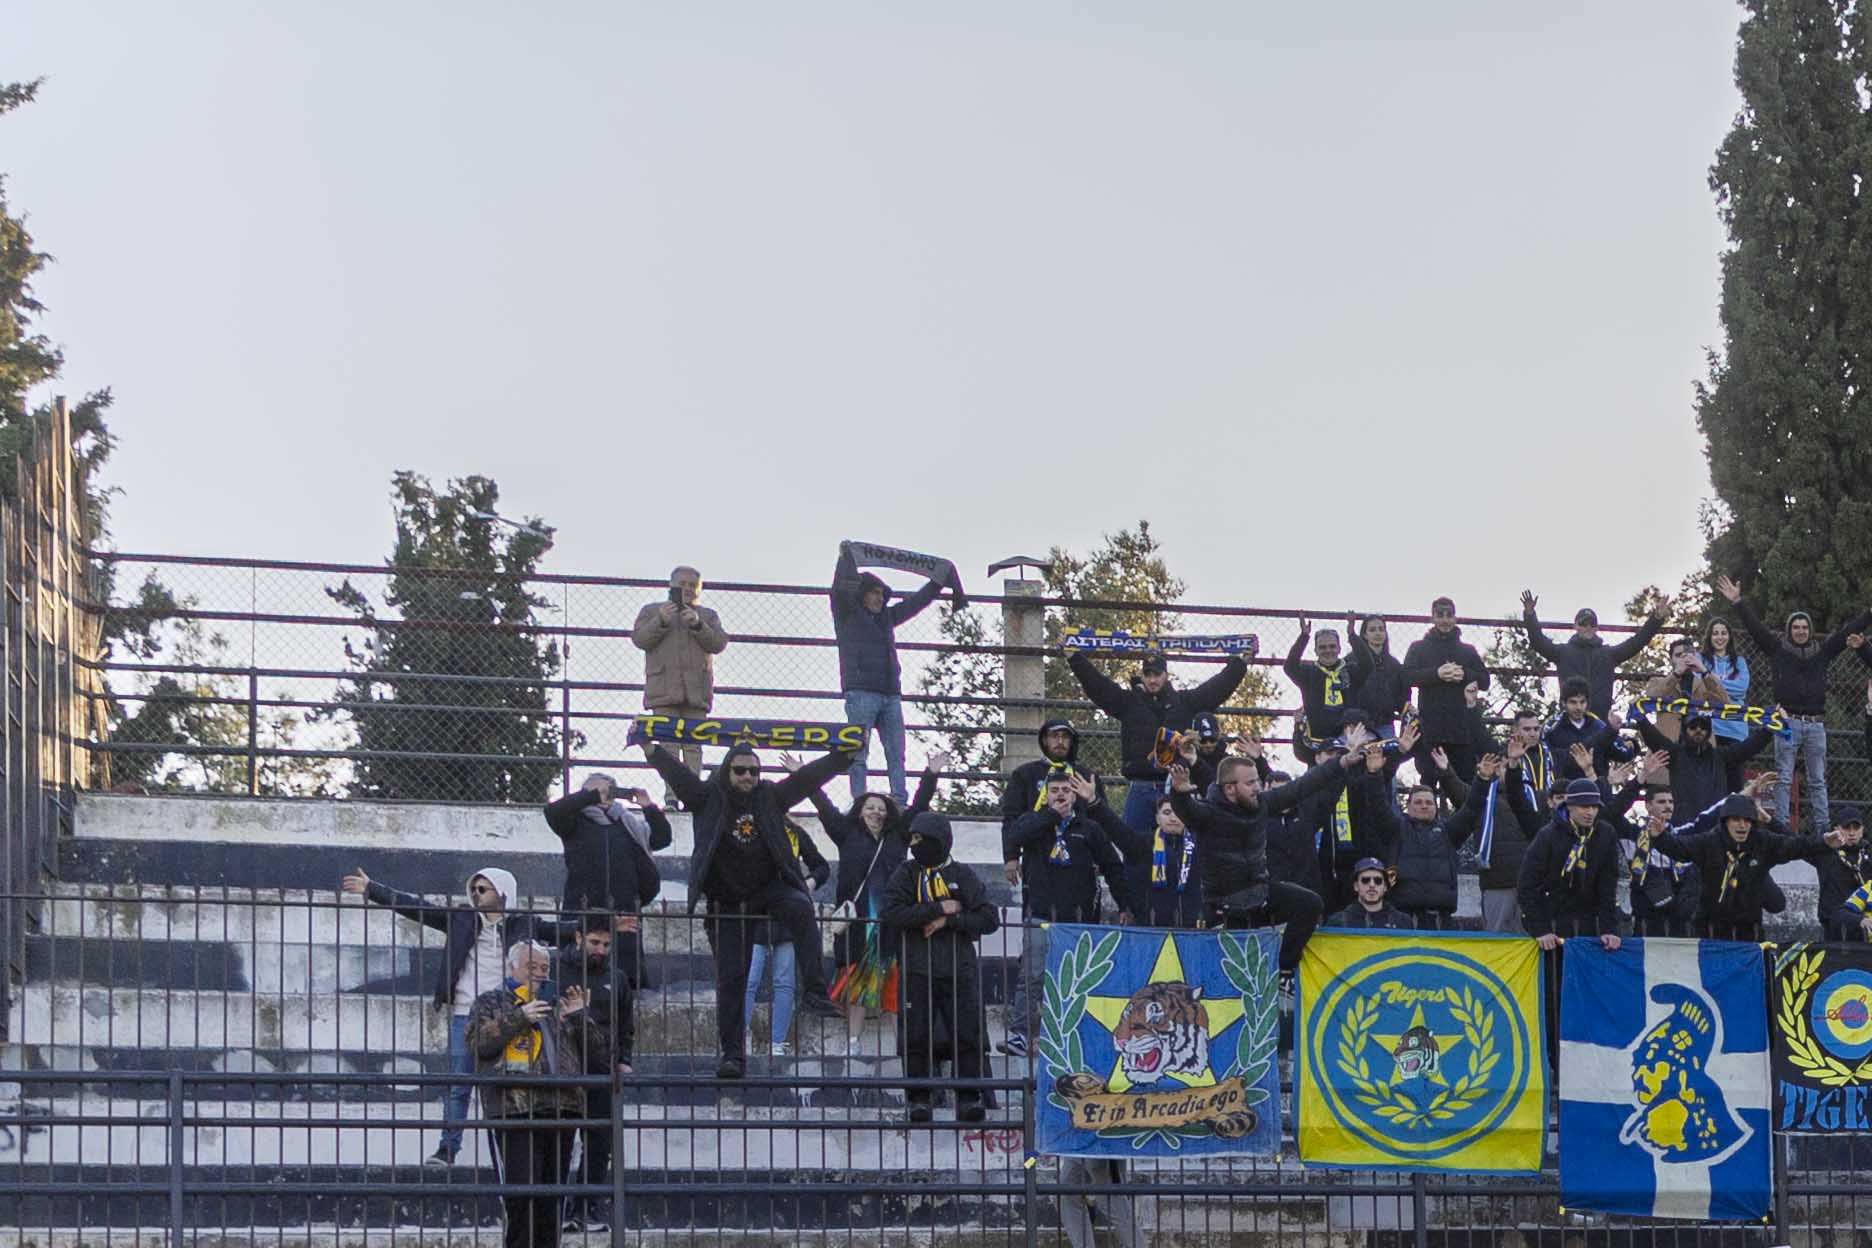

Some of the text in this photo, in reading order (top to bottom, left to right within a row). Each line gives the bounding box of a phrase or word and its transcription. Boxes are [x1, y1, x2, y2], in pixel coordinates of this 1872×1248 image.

[1083, 1090, 1238, 1123] Et in Arcadia ego
